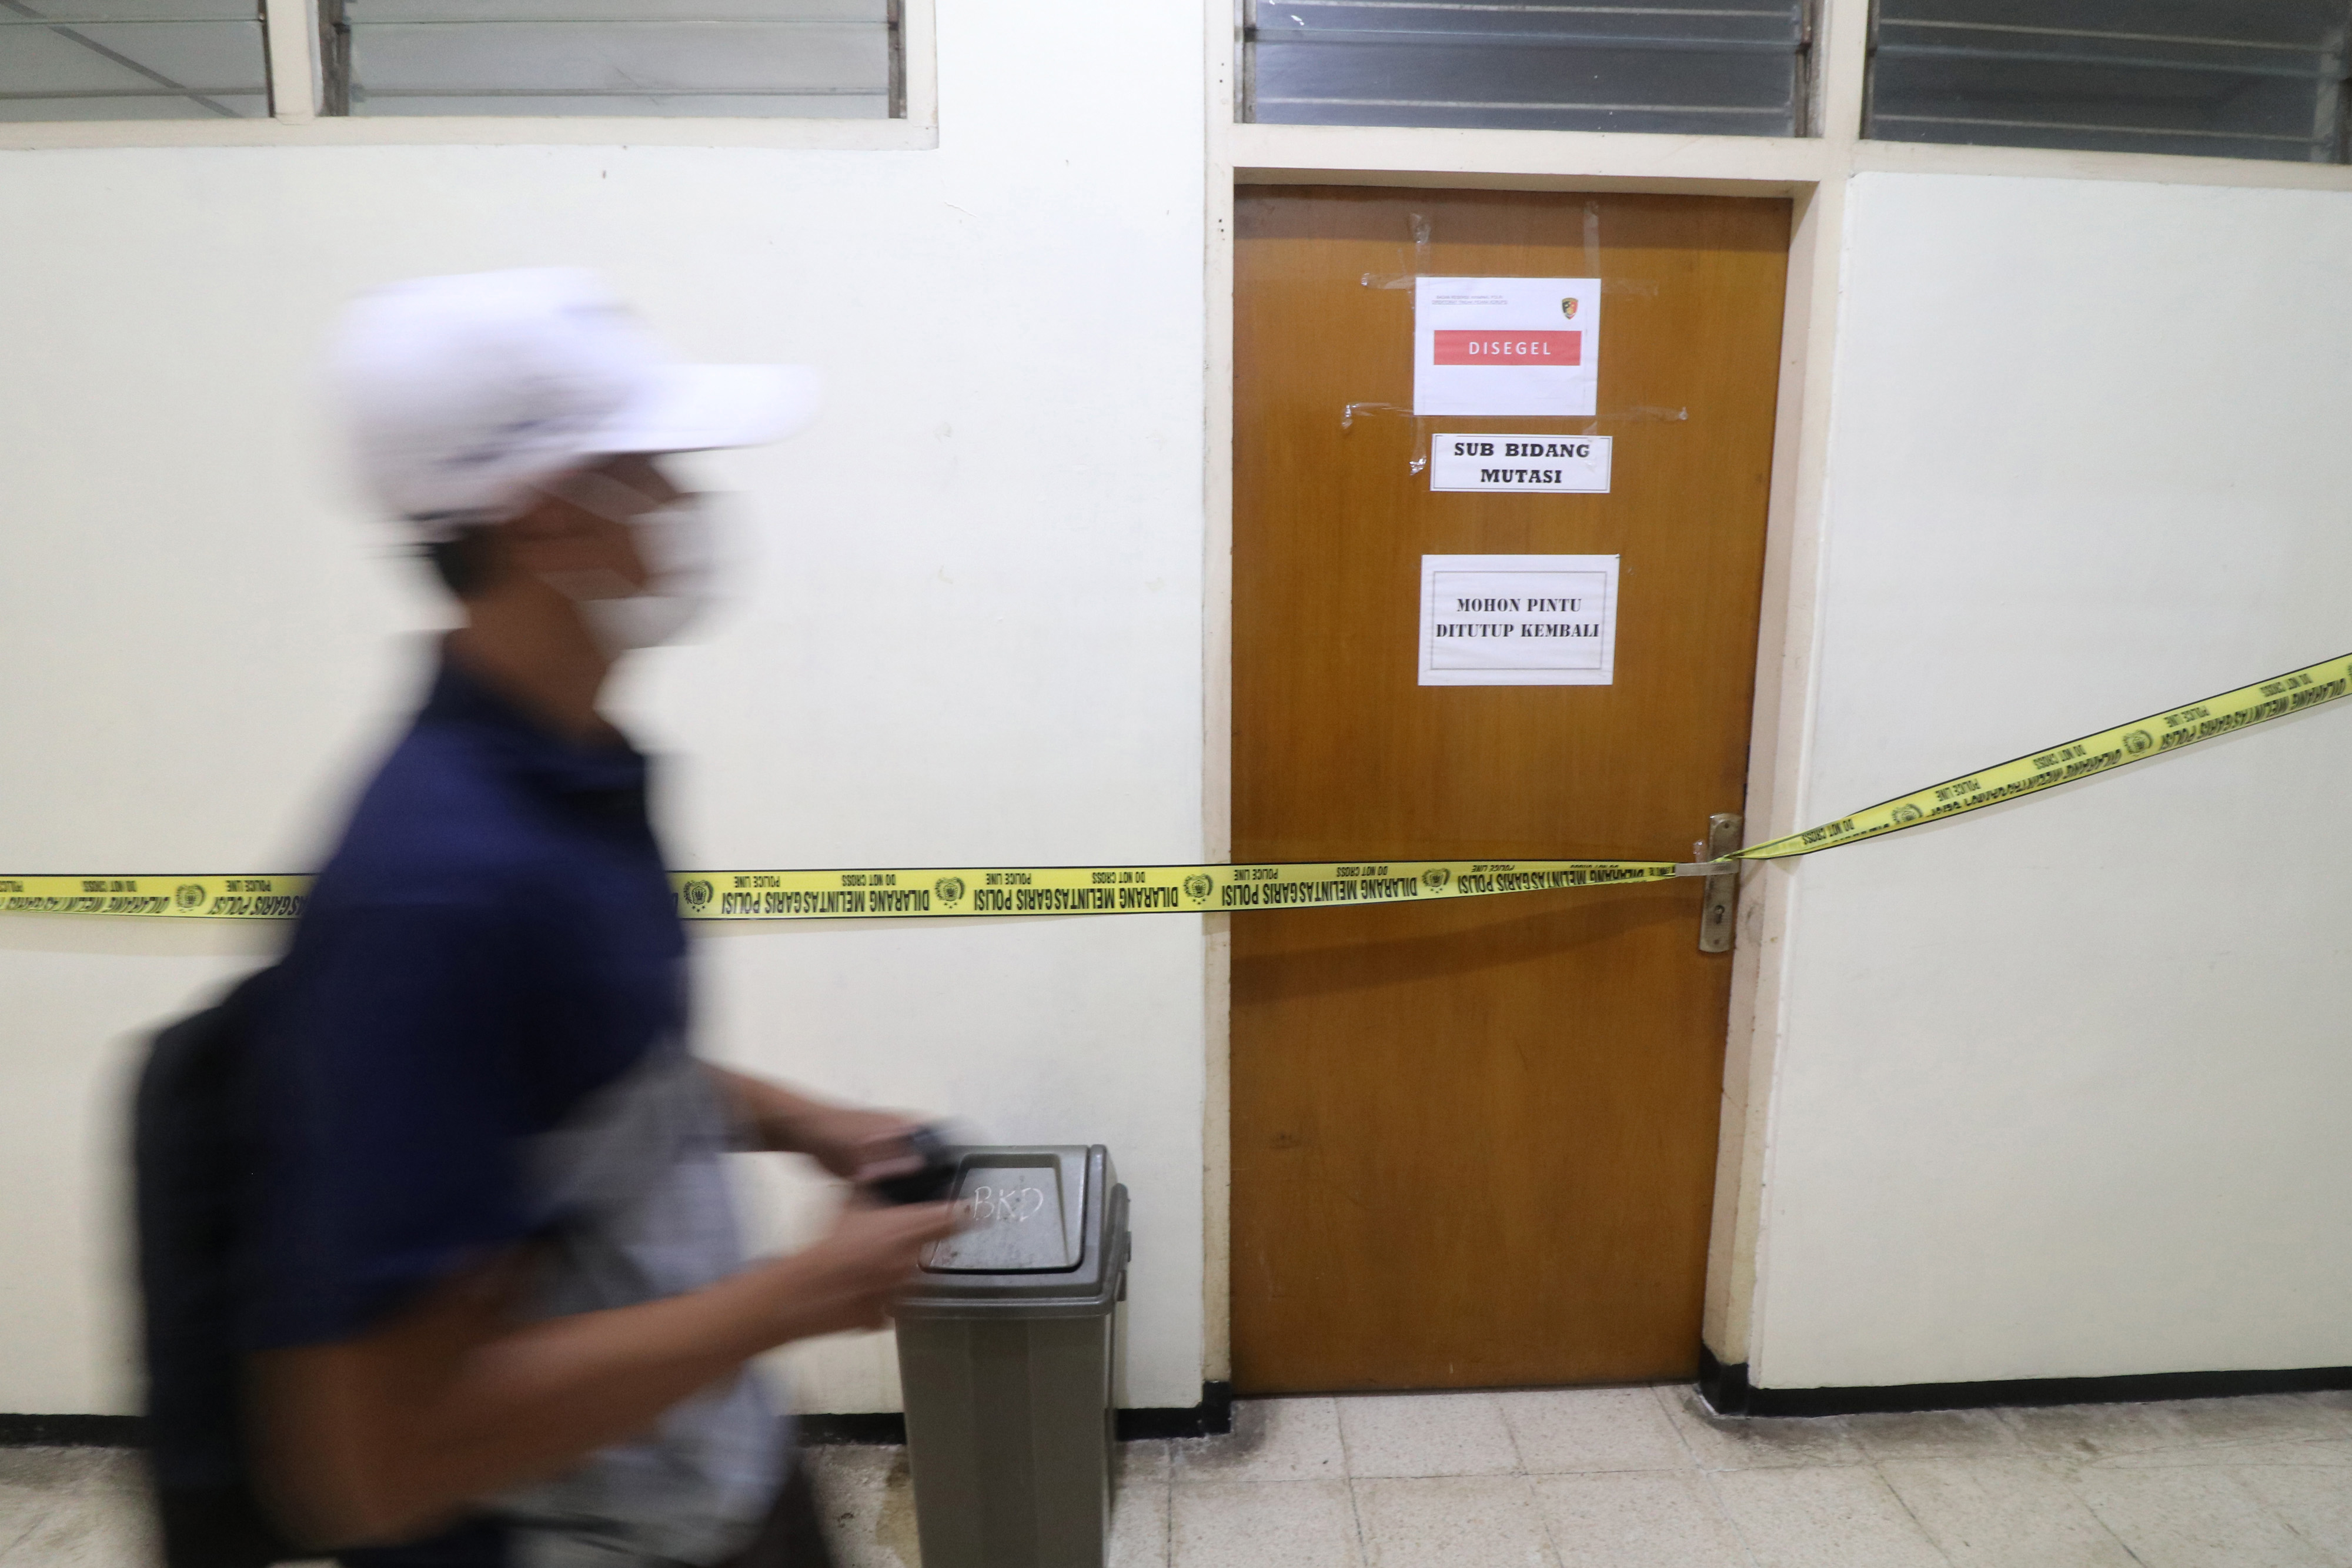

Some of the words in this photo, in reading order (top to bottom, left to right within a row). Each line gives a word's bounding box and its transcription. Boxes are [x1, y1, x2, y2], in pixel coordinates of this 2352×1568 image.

[1469, 342, 1551, 355] DISEGEL
[1454, 442, 1494, 456] SUB
[1505, 443, 1590, 457] BIDANG
[1481, 469, 1562, 483] MUTASI
[1456, 599, 1521, 612] MOHON
[1526, 599, 1582, 612] PINTU
[1436, 624, 1514, 637] DITUTUP
[1520, 624, 1600, 637] KEMBALI
[1953, 778, 1981, 797] POLICE
[1092, 872, 1117, 884] CROSS
[1118, 871, 1133, 884] NOT
[1136, 871, 1145, 883] DO
[1234, 869, 1250, 881] LINE
[1252, 868, 1279, 880] POLICE
[1336, 867, 1360, 878] CROSS
[1362, 866, 1376, 877] NOT
[1378, 866, 1388, 877] DO
[734, 876, 750, 888] LINE
[754, 875, 780, 888] POLICE
[841, 874, 866, 887] CROSS
[869, 874, 883, 886] NOT
[886, 874, 896, 886] DO
[986, 873, 1003, 885] LINE
[1005, 872, 1032, 885] POLICE
[1457, 874, 1494, 894] POLISI
[1361, 878, 1418, 899] DILARANG
[870, 889, 930, 911] DILARANG
[974, 889, 1012, 911] POLISI
[1119, 887, 1178, 908] DILARANG
[1221, 884, 1259, 907] POLISI
[721, 892, 761, 914] POLISI
[973, 1185, 1044, 1223] BKD
